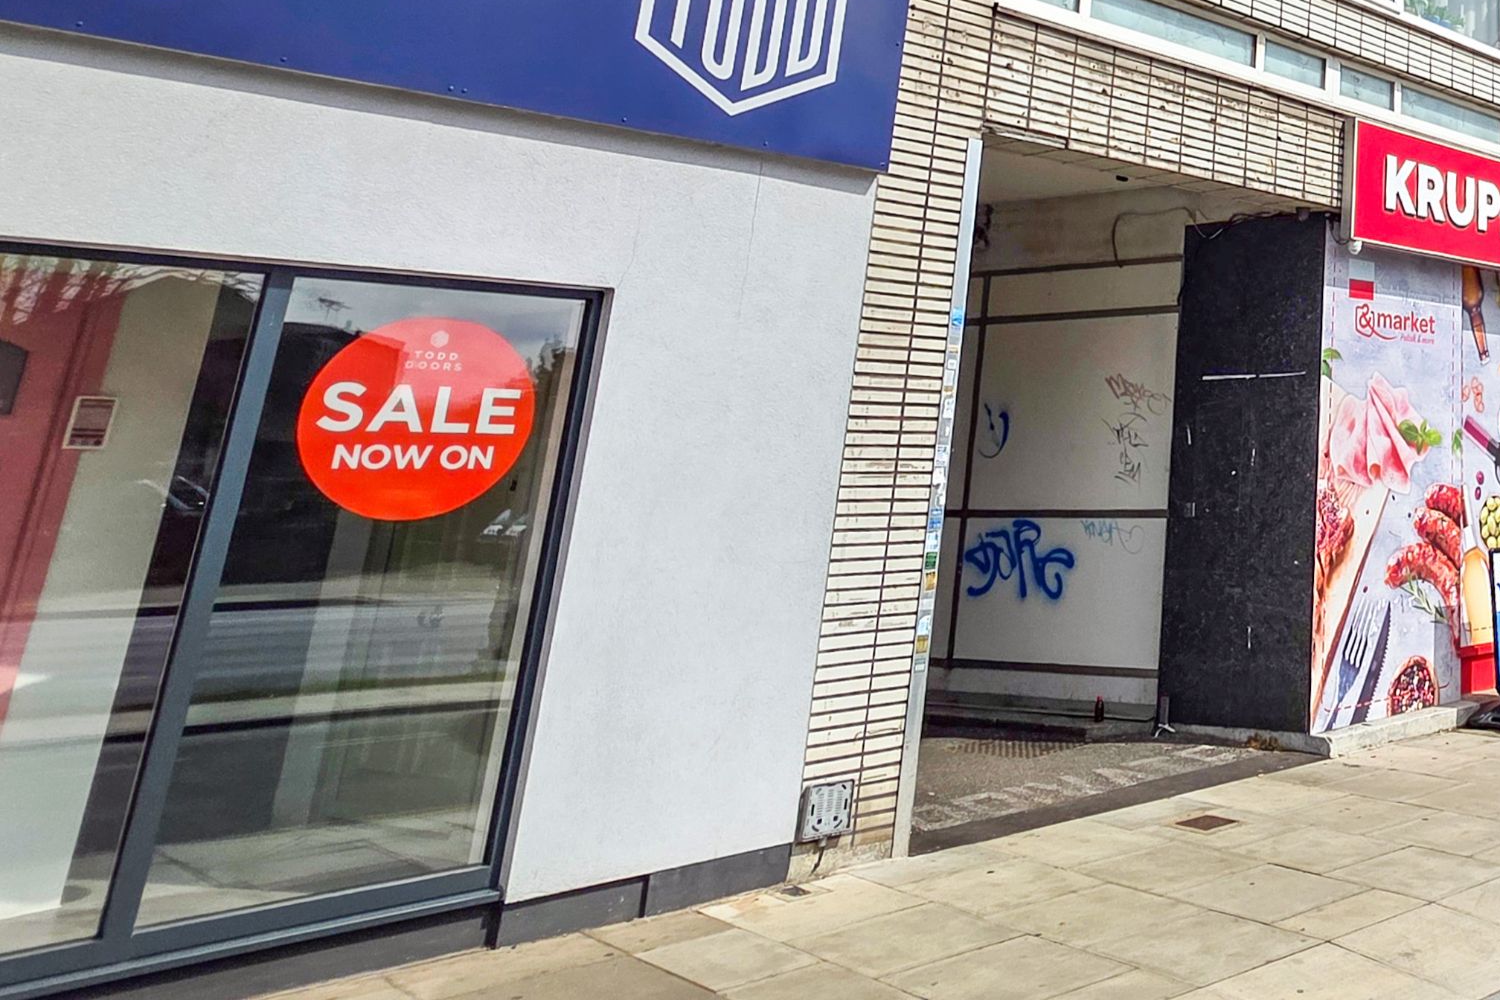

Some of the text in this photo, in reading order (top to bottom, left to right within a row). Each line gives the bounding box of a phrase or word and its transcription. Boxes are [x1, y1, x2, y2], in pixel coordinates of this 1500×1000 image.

[413, 350, 459, 361] TODD
[405, 360, 463, 372] DOORS
[315, 381, 522, 435] SALE
[331, 443, 495, 470] NOW ON
